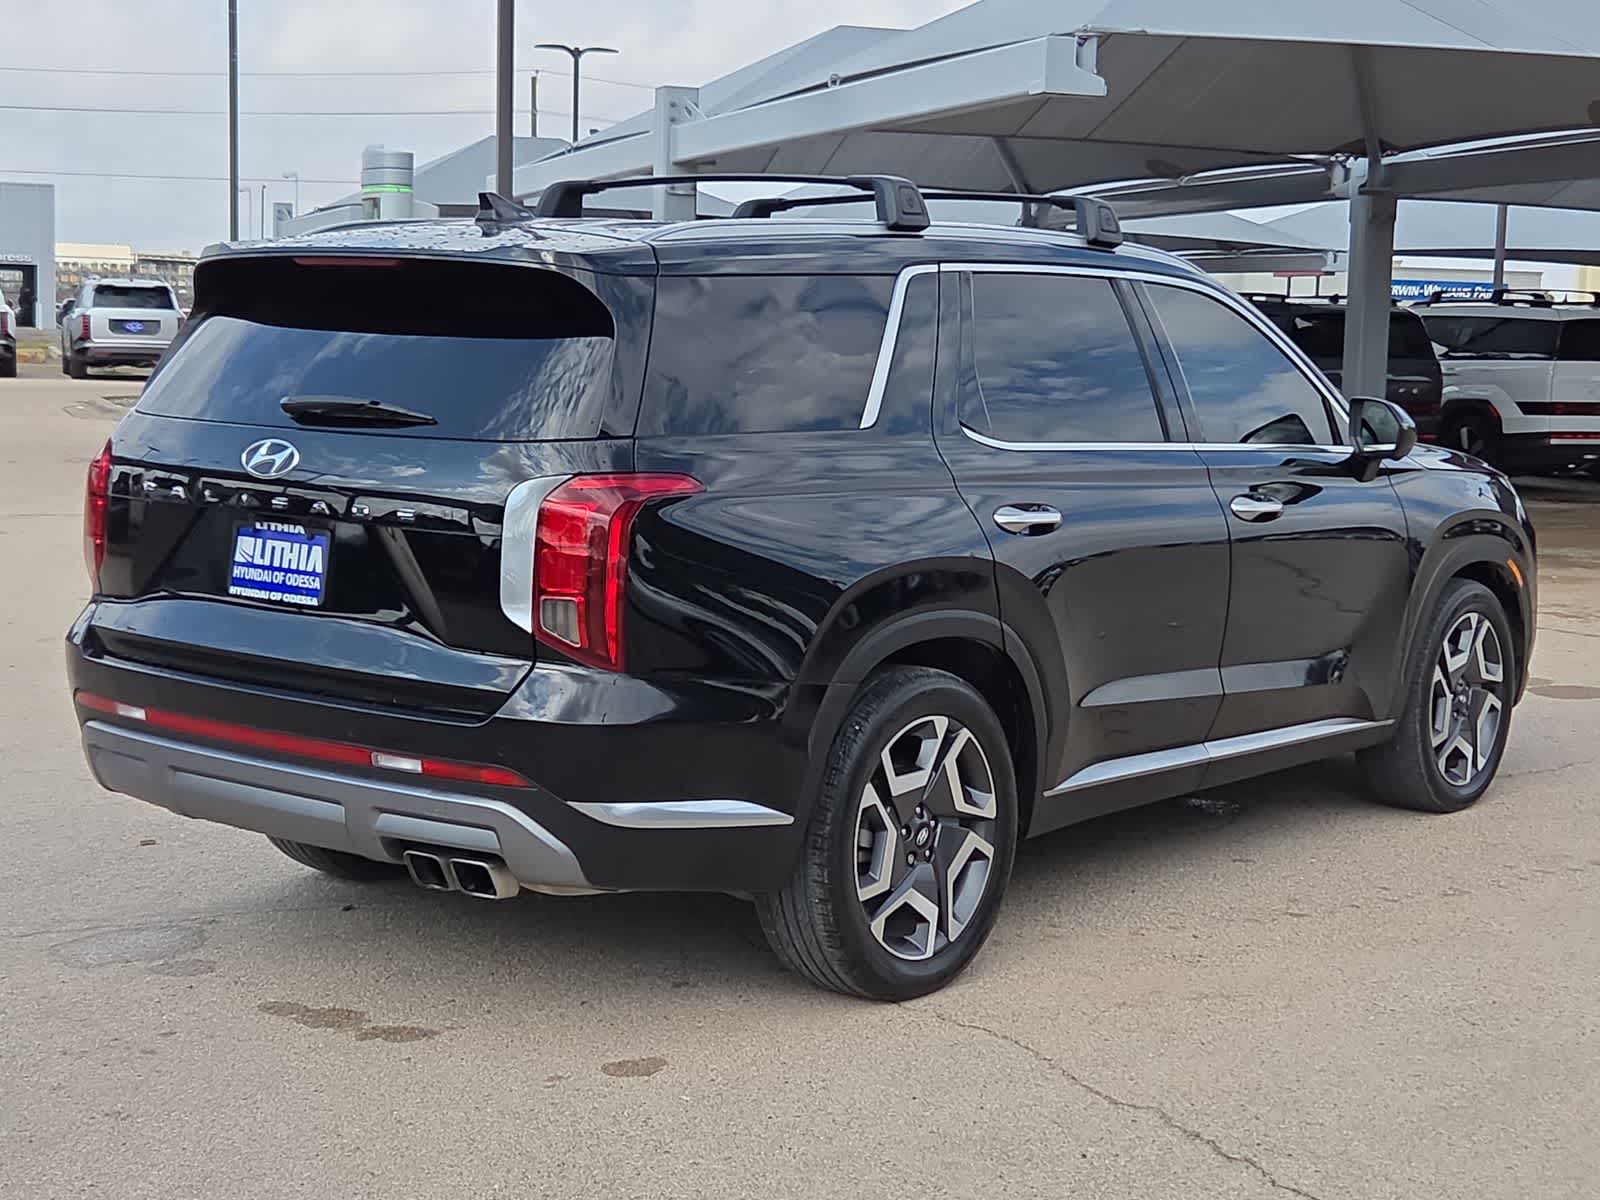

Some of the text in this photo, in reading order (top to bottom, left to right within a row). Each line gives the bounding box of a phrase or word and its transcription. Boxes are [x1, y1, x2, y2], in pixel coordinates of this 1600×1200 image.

[255, 521, 305, 534] LITHIA
[253, 538, 322, 573] LITHIA
[233, 565, 320, 590] HYUNDAI OF ODESSA
[229, 586, 318, 606] HYUNDAI OF ODESSA
